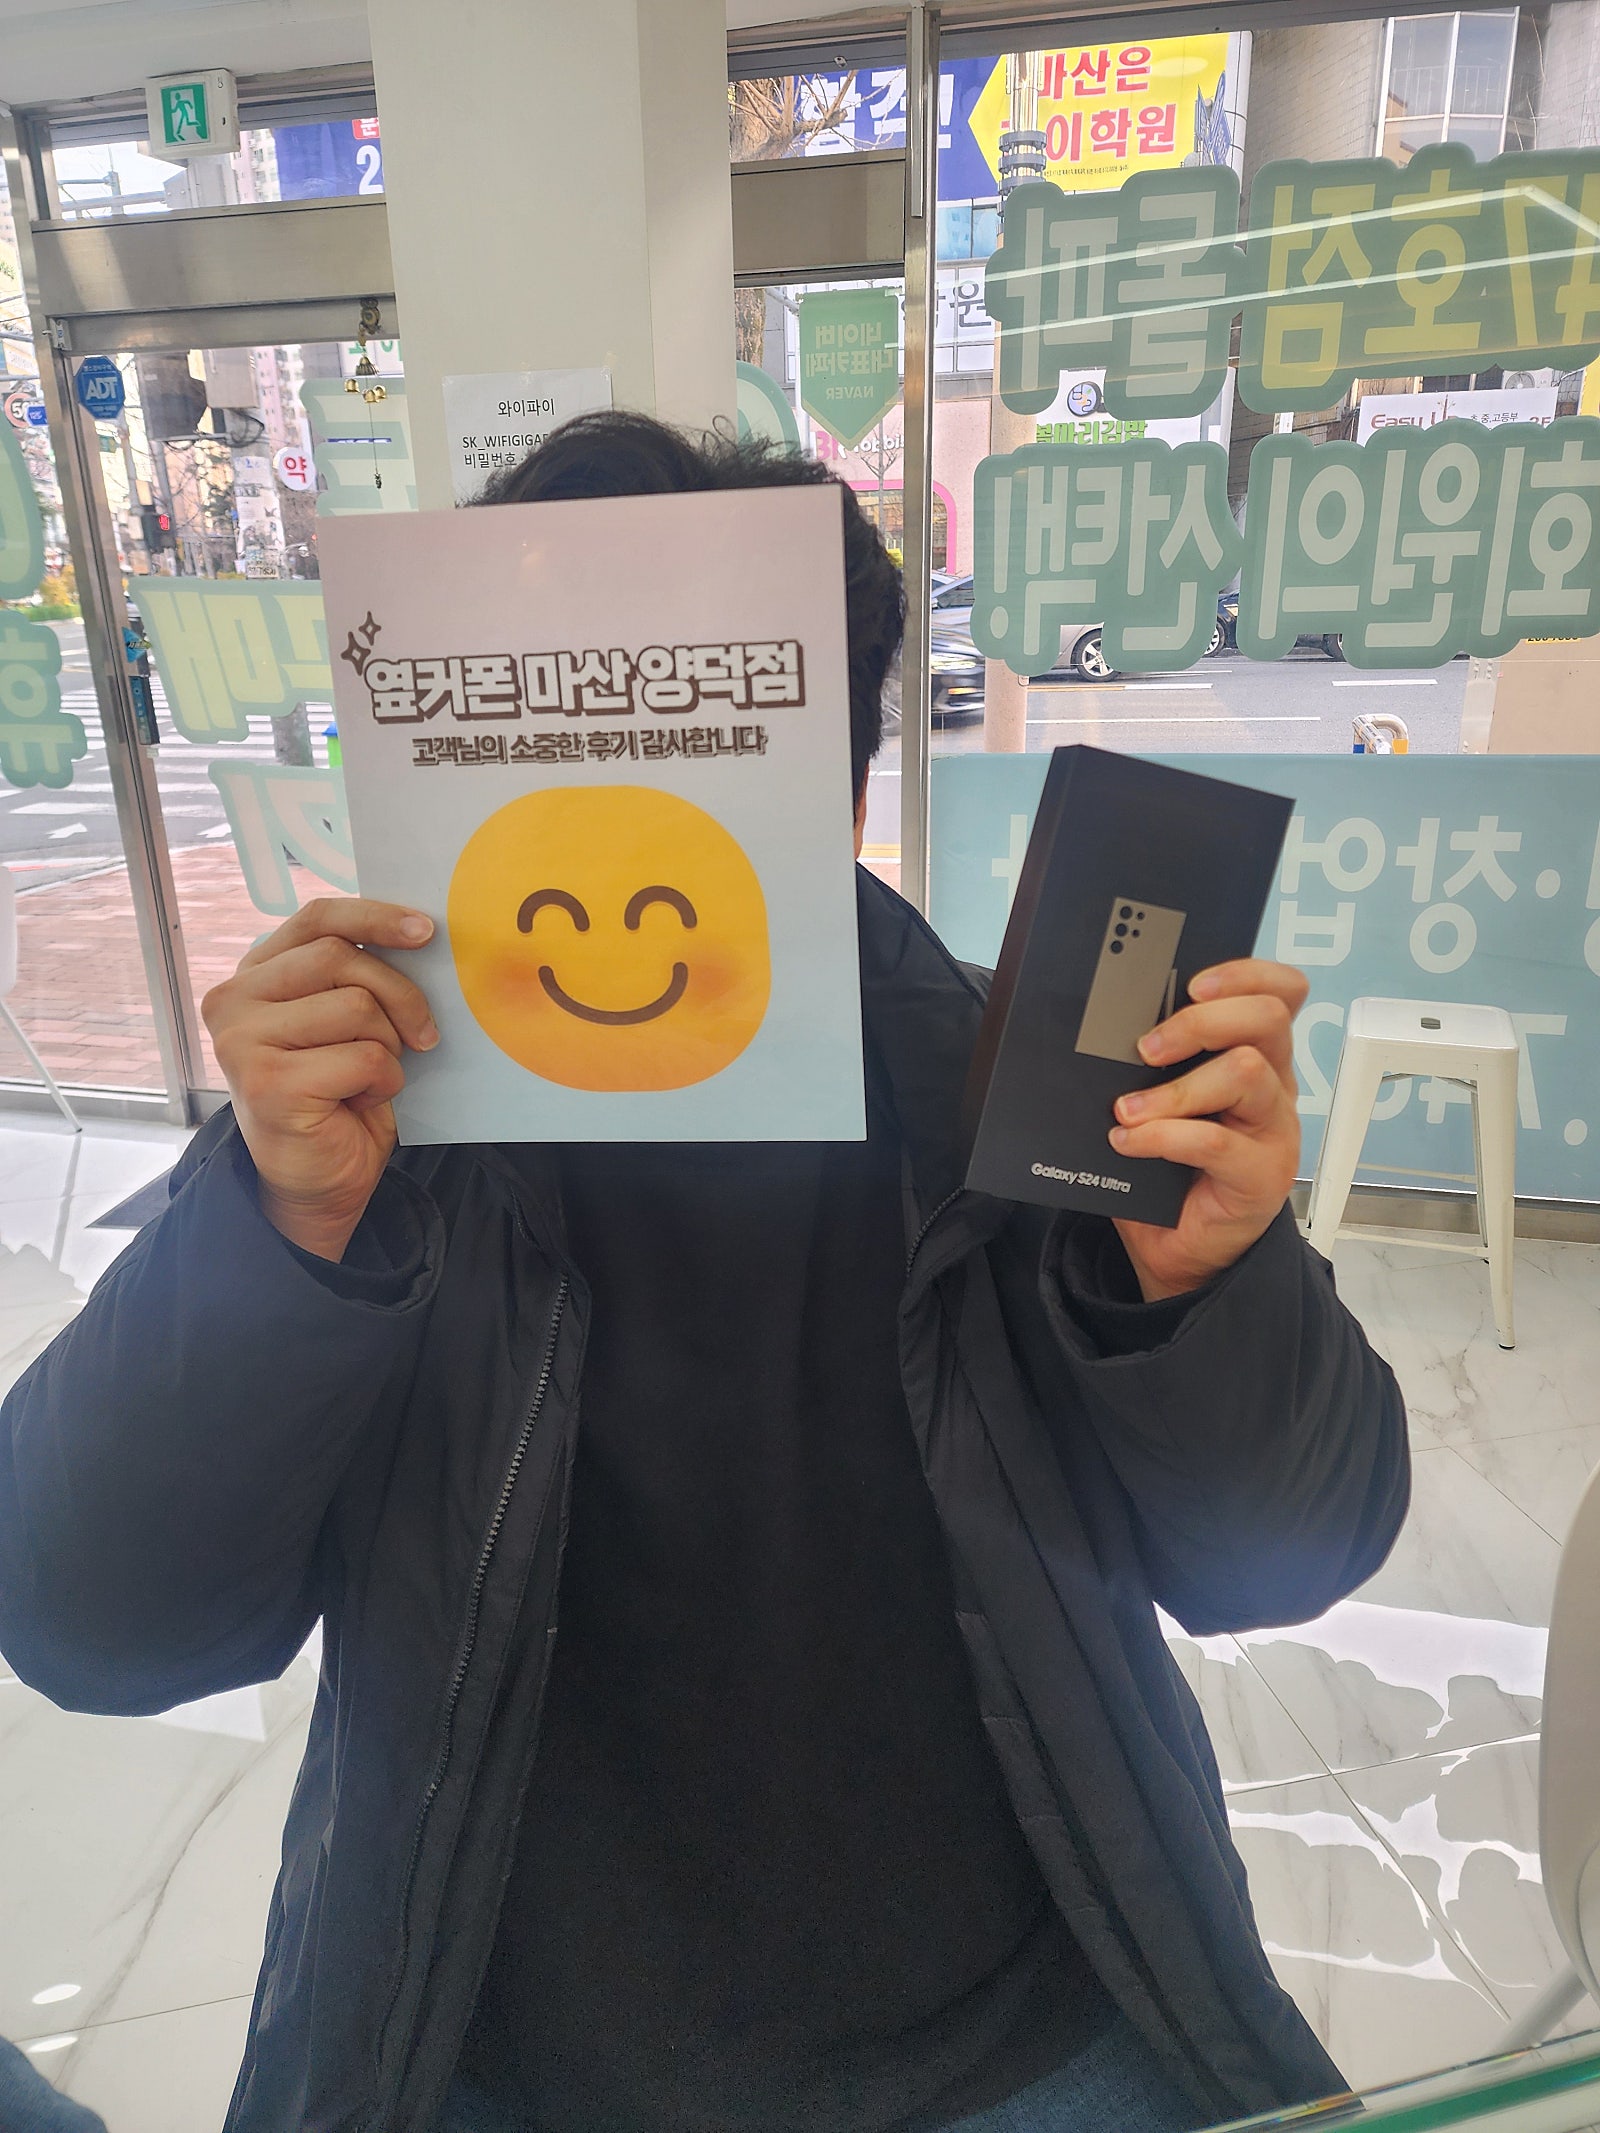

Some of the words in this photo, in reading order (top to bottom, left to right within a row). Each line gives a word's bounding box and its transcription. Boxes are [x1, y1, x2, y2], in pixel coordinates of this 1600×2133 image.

[1001, 103, 1176, 162] 이학원
[86, 377, 118, 400] ADT
[497, 398, 555, 417] 와이파이
[283, 456, 307, 484] 약
[364, 652, 522, 724] 옆커폰
[522, 647, 636, 716] 마산
[636, 640, 806, 714] 양덕점
[411, 735, 508, 767] 고객님의
[510, 731, 586, 763] 소중한
[586, 729, 637, 761] 후기
[638, 725, 768, 759] 감사합니다
[1031, 1162, 1078, 1185] Galaxy
[1076, 1172, 1101, 1187] S24
[1100, 1176, 1132, 1194] Ultra
